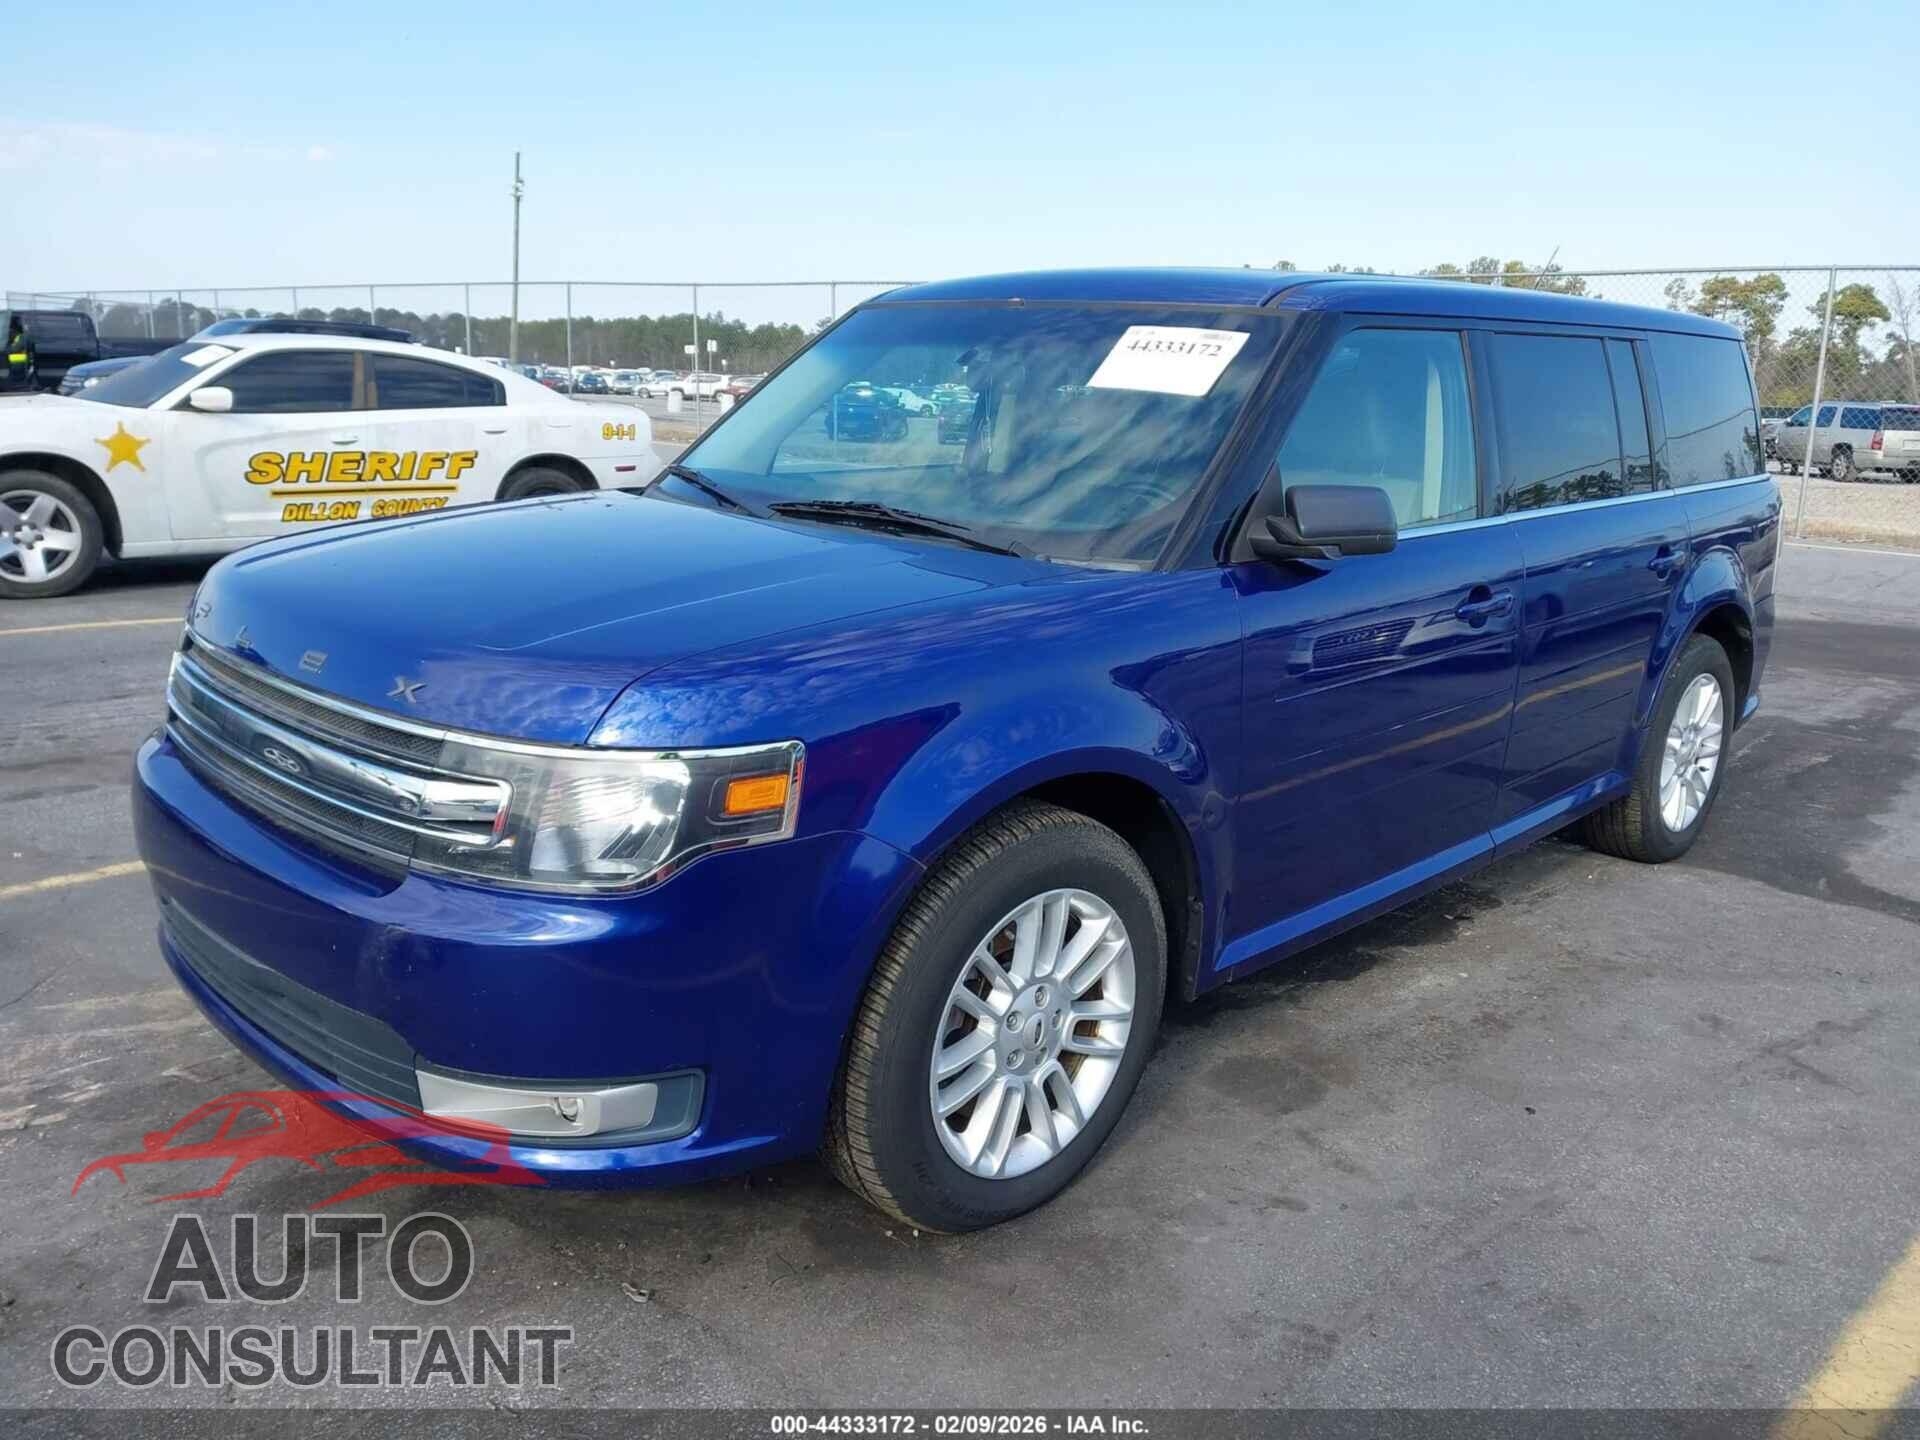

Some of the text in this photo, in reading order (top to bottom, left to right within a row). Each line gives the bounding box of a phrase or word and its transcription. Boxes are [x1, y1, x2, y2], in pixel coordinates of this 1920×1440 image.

[1126, 339, 1223, 357] 44333172
[602, 422, 636, 441] 9-1-1
[244, 450, 478, 485] SHERIFF
[281, 500, 361, 522] DILLON
